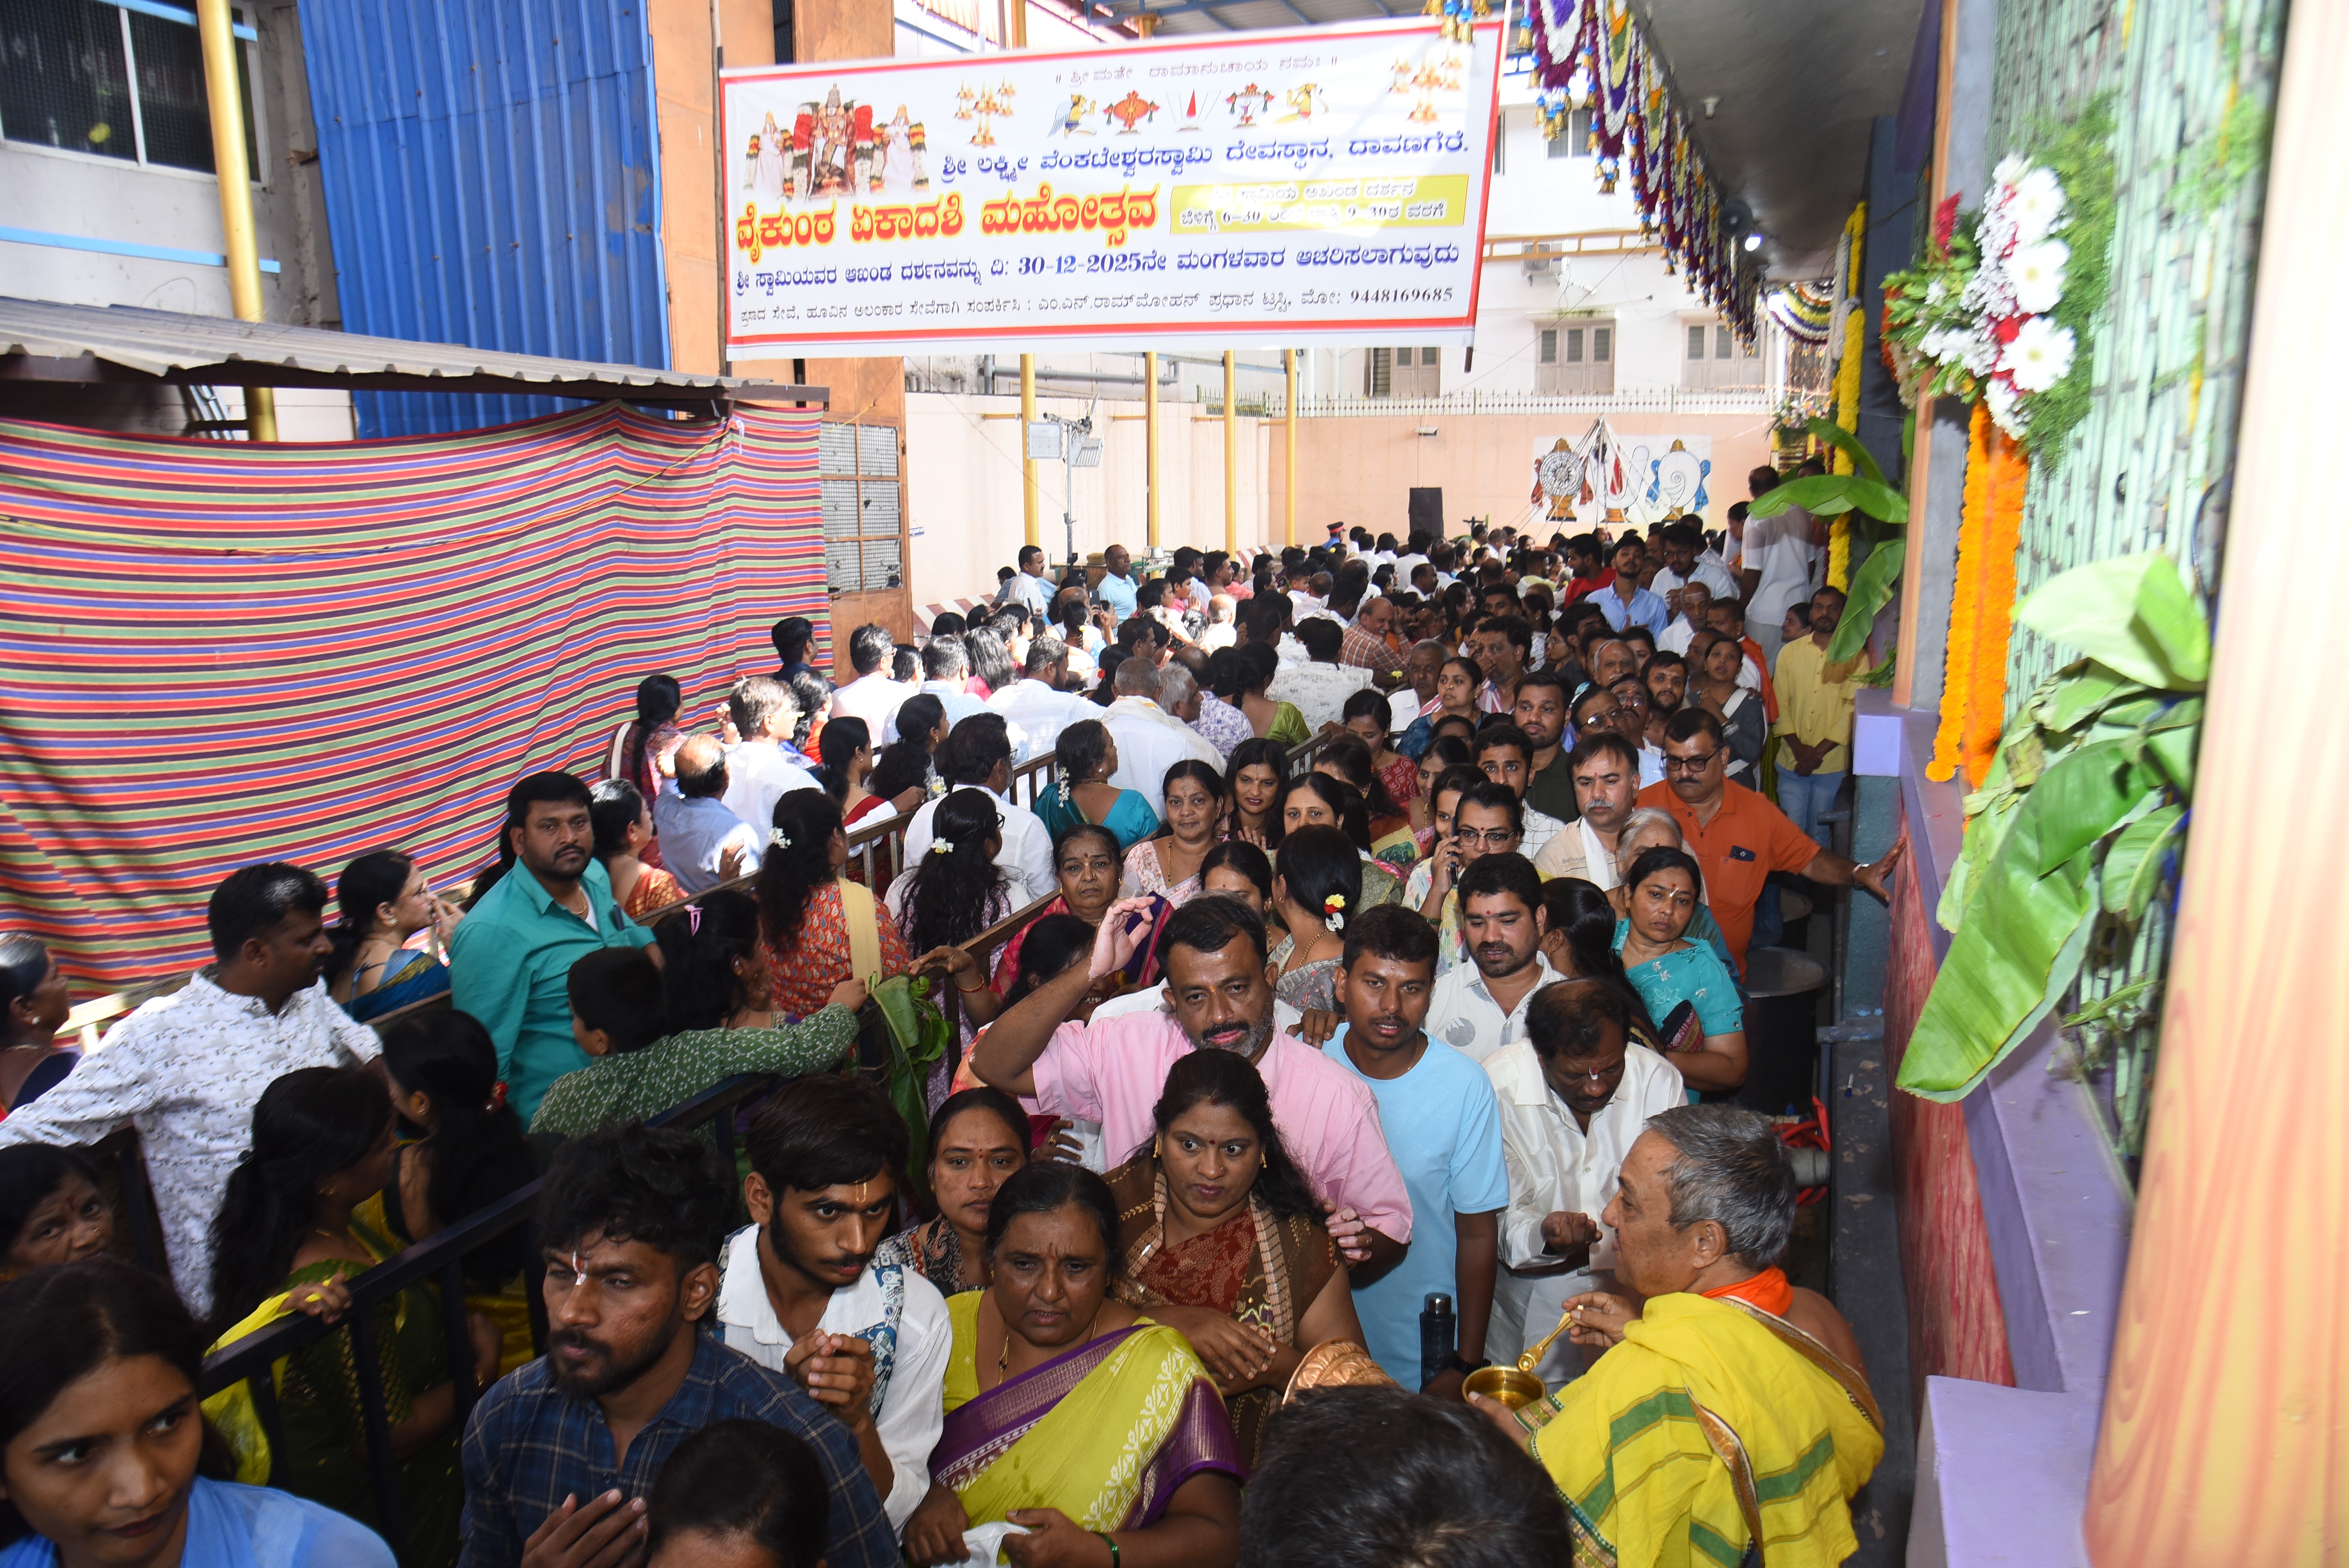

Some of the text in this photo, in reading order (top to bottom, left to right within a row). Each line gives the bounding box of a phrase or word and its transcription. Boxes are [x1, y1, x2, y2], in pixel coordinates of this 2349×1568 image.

[940, 155, 967, 183] ಶ್ರೀ
[977, 155, 1028, 183] ಲಕ್ಷ್ಮೀ
[1040, 146, 1213, 177] ವೆಂಕಟೇಶ್ವರಸ್ವಾಮಿ
[1226, 137, 1334, 171] ದೇವಸ್ಥಾನ,
[736, 182, 1161, 265] ವೈಕುಂಠ ಏಕಾದಶಿ ಮಹೋತ್ಸವ
[736, 270, 750, 297] ಶ್ರೀ
[755, 265, 838, 297] ಸ್ವಾಮಿಯವರ
[900, 257, 982, 286] ದರ್ಶನವನ್ನು
[1177, 246, 1286, 270] ಮಂಗಳವಾರ
[1296, 242, 1460, 270] ಆಚರಿಸಲಾಗುವುದು
[740, 306, 767, 327] ಪ್ರಸಾದ
[806, 303, 849, 320] ಹೂವಿನ
[854, 301, 904, 319] ಅಲಂಕಾರ
[909, 298, 961, 317] ಸೇವೆಗಾಗಿ
[966, 296, 1021, 314] ಸಂಪರ್ಕಿಸಿ
[1208, 290, 1255, 313] ಪ್ರಧಾನ
[1349, 287, 1453, 305] 9448169685
